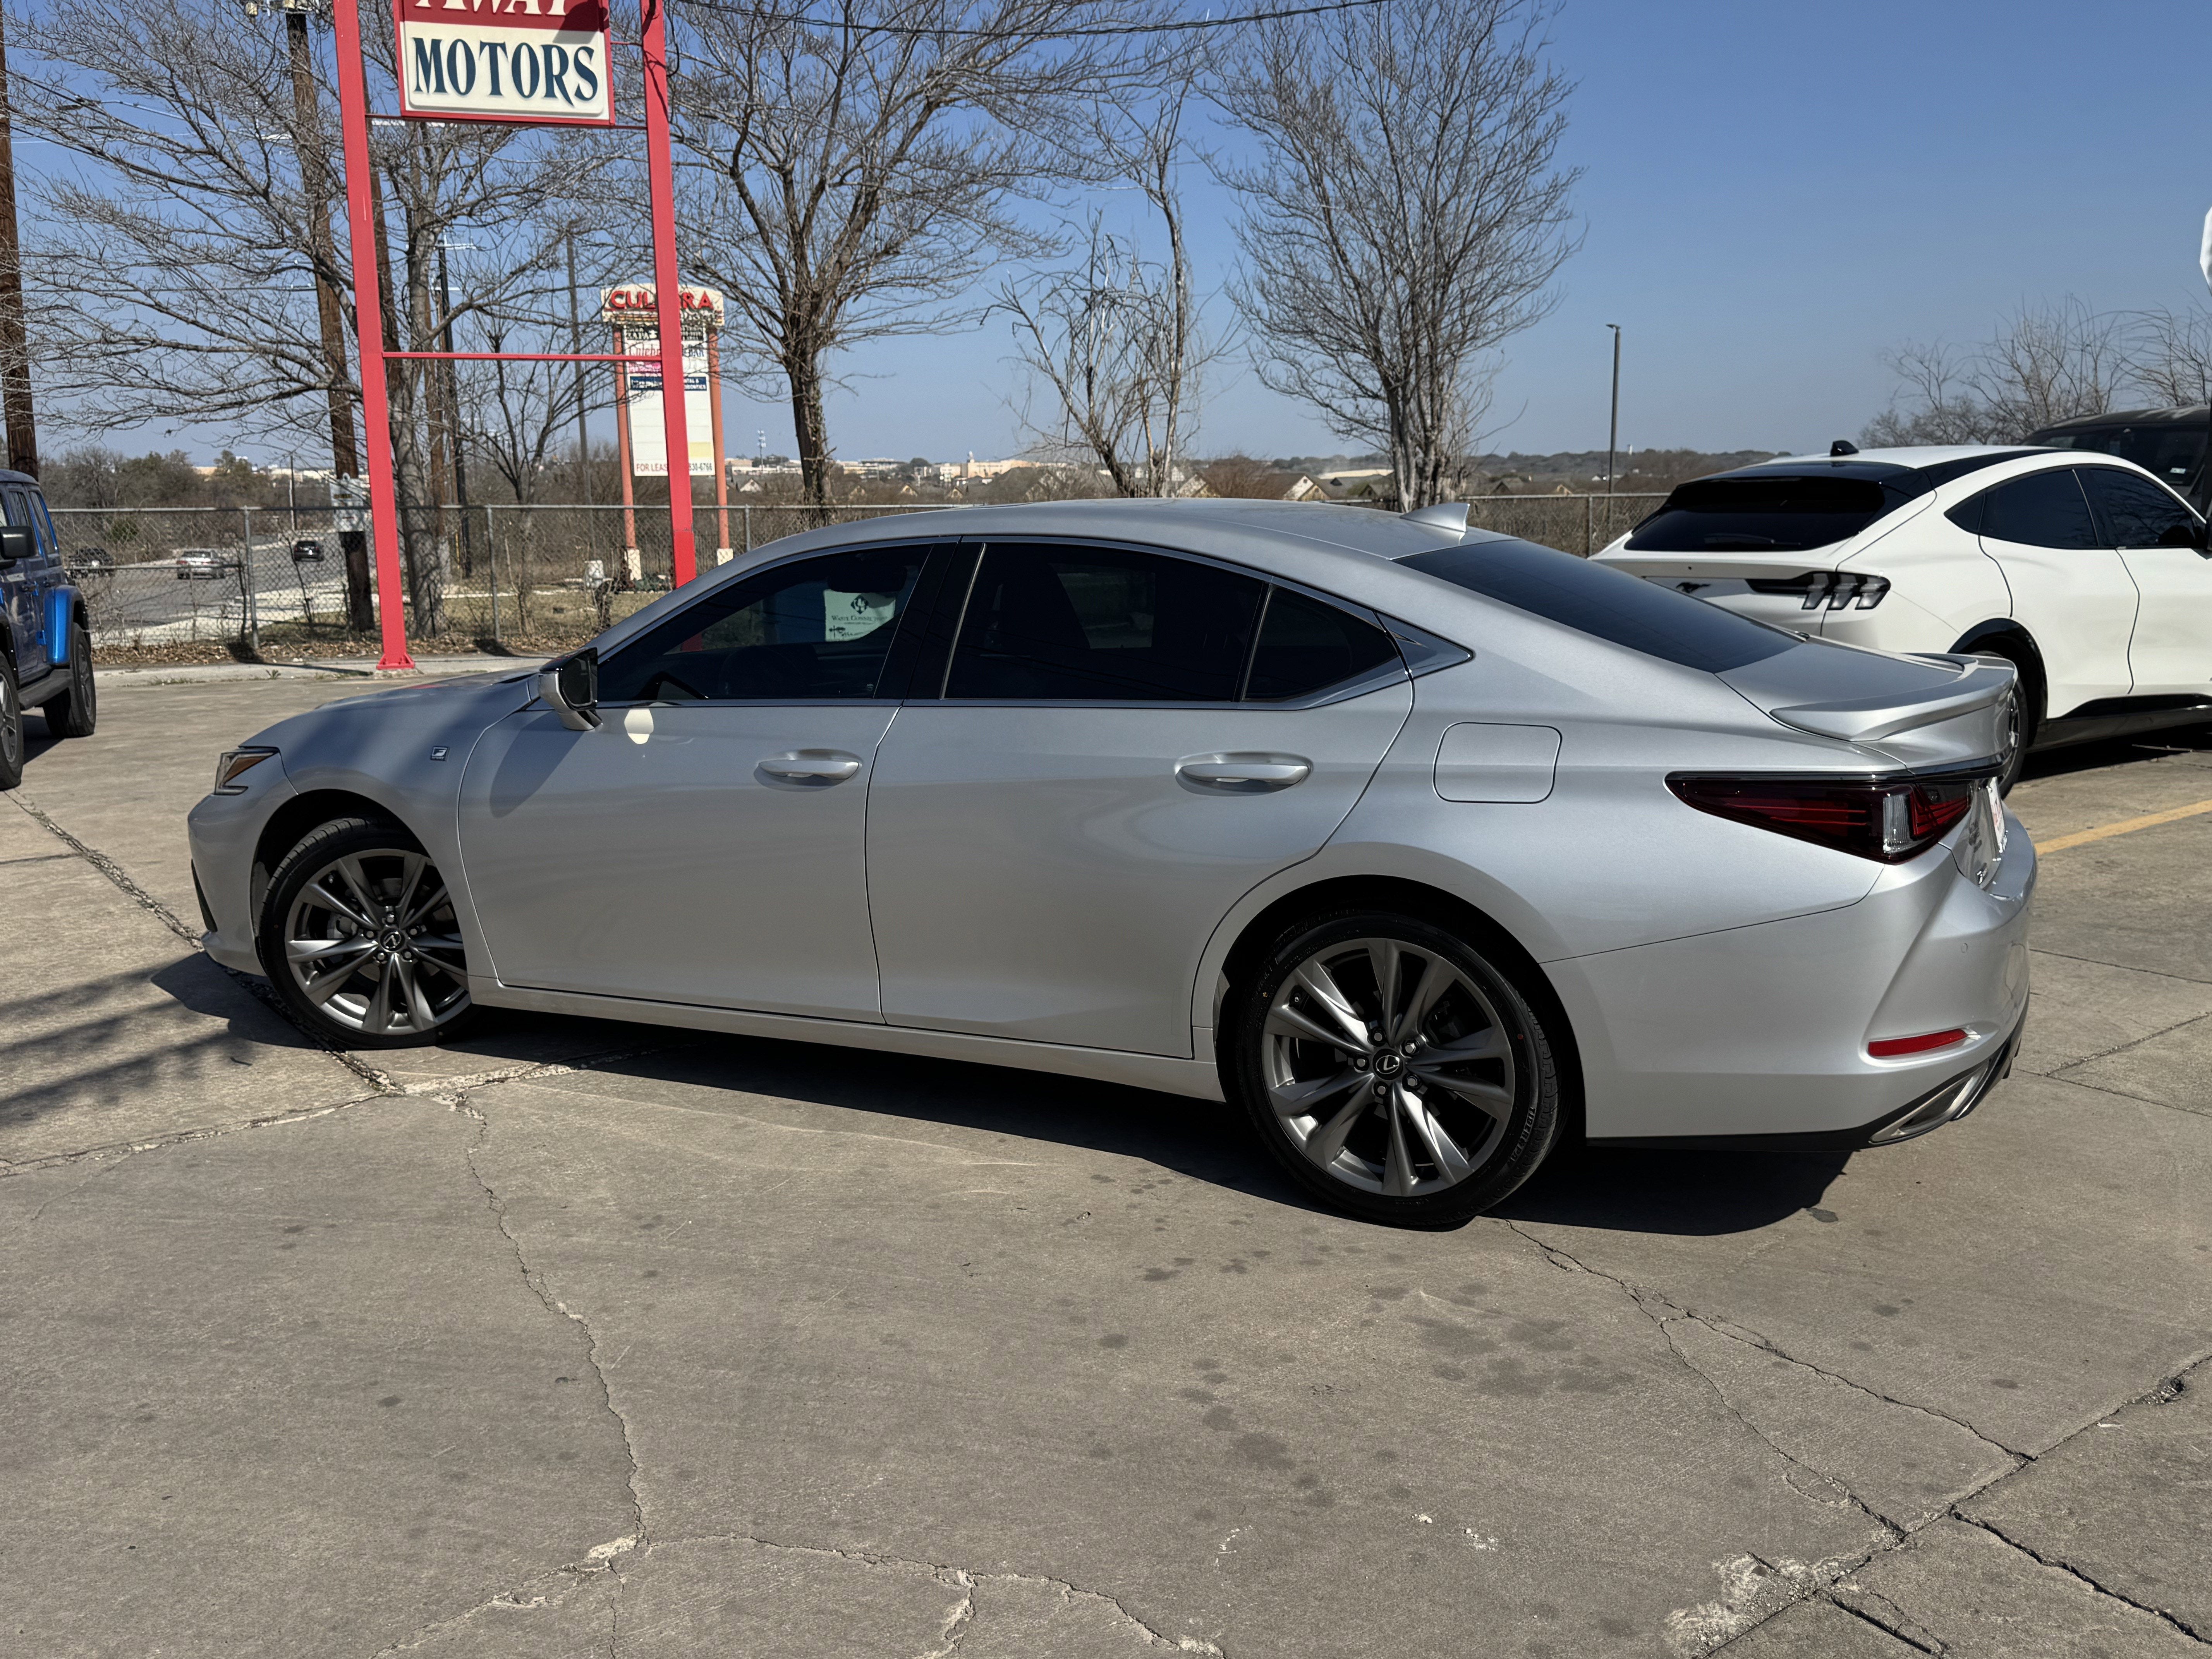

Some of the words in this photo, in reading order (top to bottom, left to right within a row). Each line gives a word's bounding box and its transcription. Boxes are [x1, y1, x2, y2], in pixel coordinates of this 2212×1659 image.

[412, 38, 598, 107] MOTORS
[610, 290, 714, 310] CULRA
[636, 463, 650, 471] FOR
[651, 463, 668, 472] LEAS
